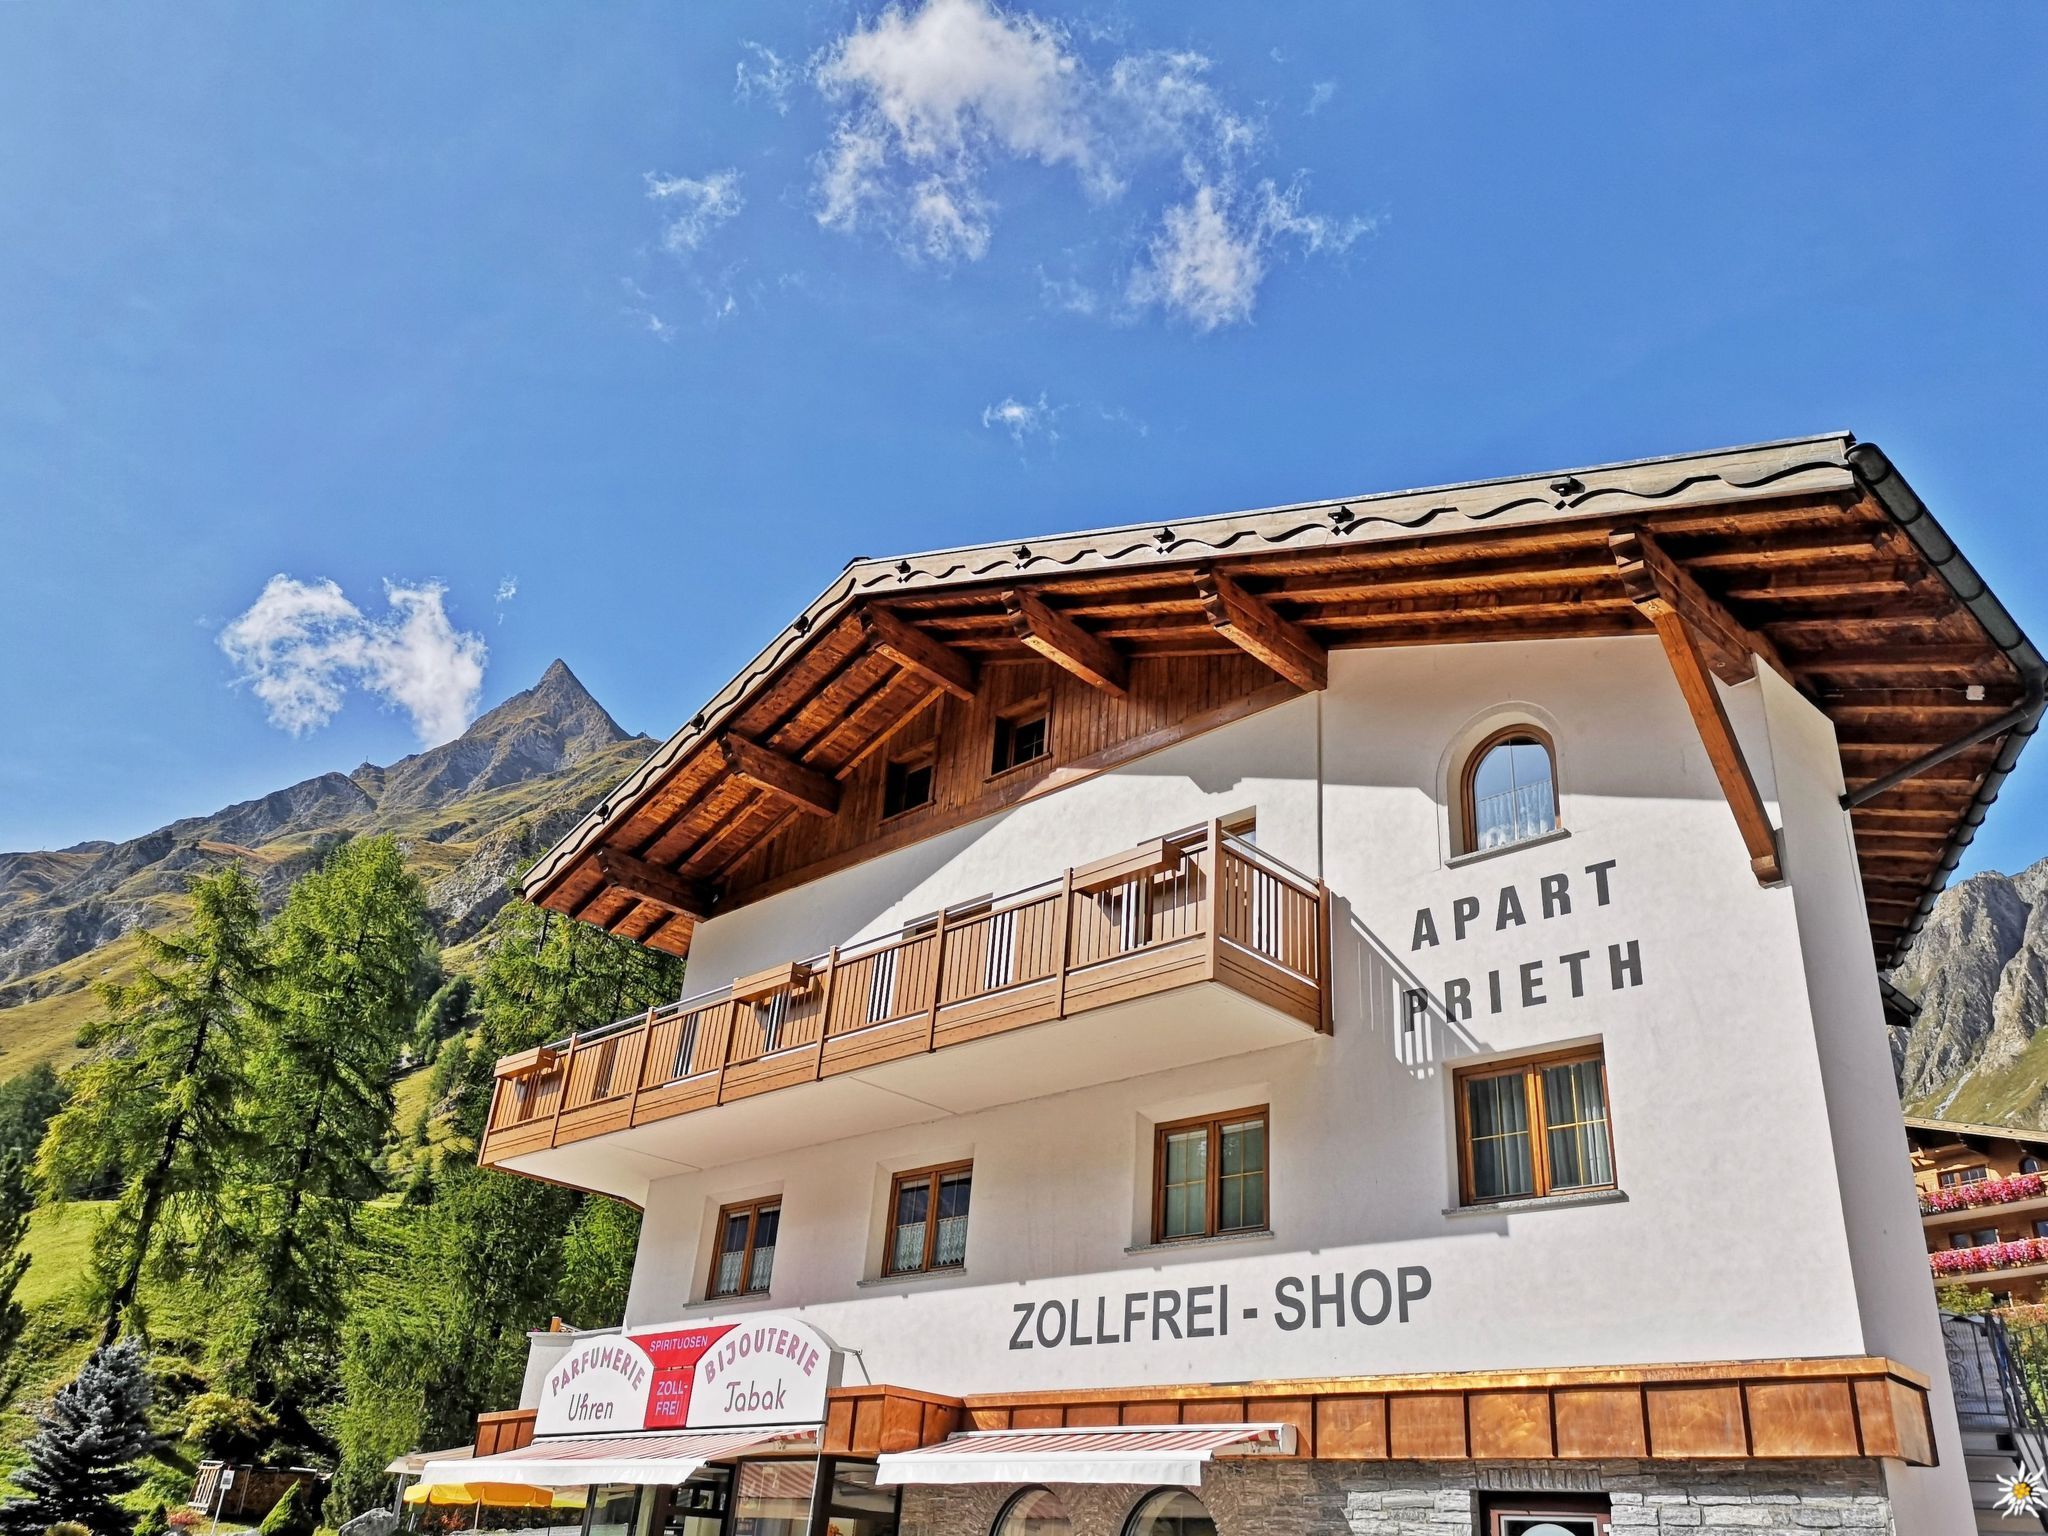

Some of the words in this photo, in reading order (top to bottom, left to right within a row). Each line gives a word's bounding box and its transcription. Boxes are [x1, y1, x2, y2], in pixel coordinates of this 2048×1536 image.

[1411, 859, 1616, 951] APART
[1402, 939, 1644, 1032] PRIETH
[1009, 1284, 1228, 1350] ZOLLFREI
[1274, 1265, 1432, 1331] SHOP
[649, 1336, 708, 1352] SPIRITUOSEN
[704, 1328, 819, 1384] BIJOUTERIE
[551, 1346, 645, 1397] PARFUMERIE
[656, 1380, 688, 1396] ZOLL-
[568, 1393, 613, 1421] Uhren
[655, 1400, 680, 1416] FREI
[724, 1378, 787, 1413] Tabak
